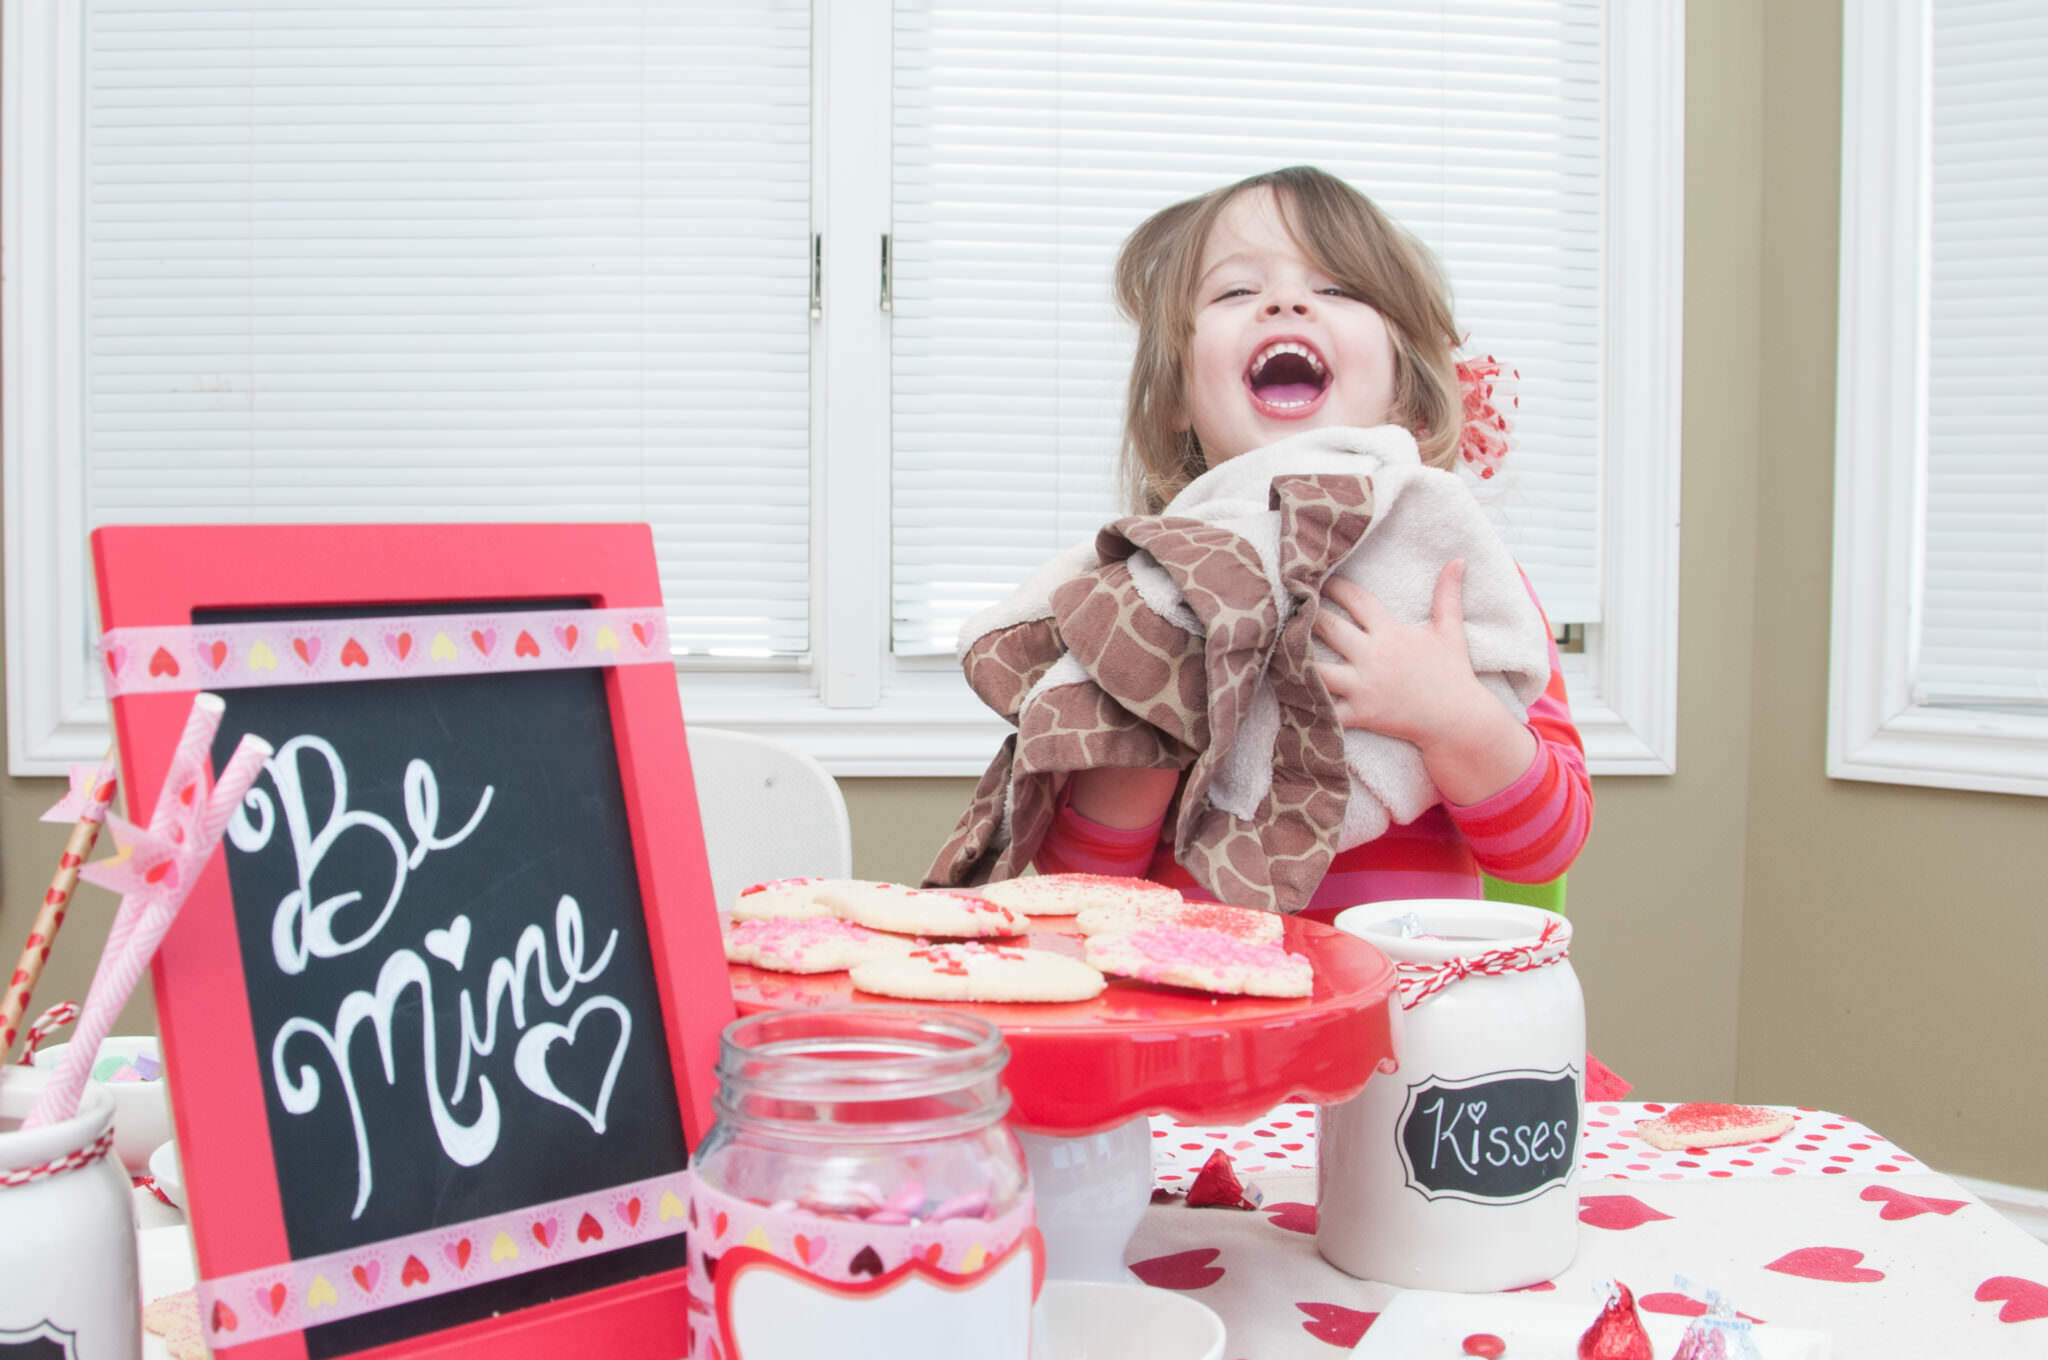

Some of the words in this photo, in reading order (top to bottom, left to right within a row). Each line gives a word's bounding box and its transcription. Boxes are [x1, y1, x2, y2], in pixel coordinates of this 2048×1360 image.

[227, 735, 494, 974] Be
[272, 894, 618, 1220] Mine
[1423, 1097, 1568, 1176] Kisses
